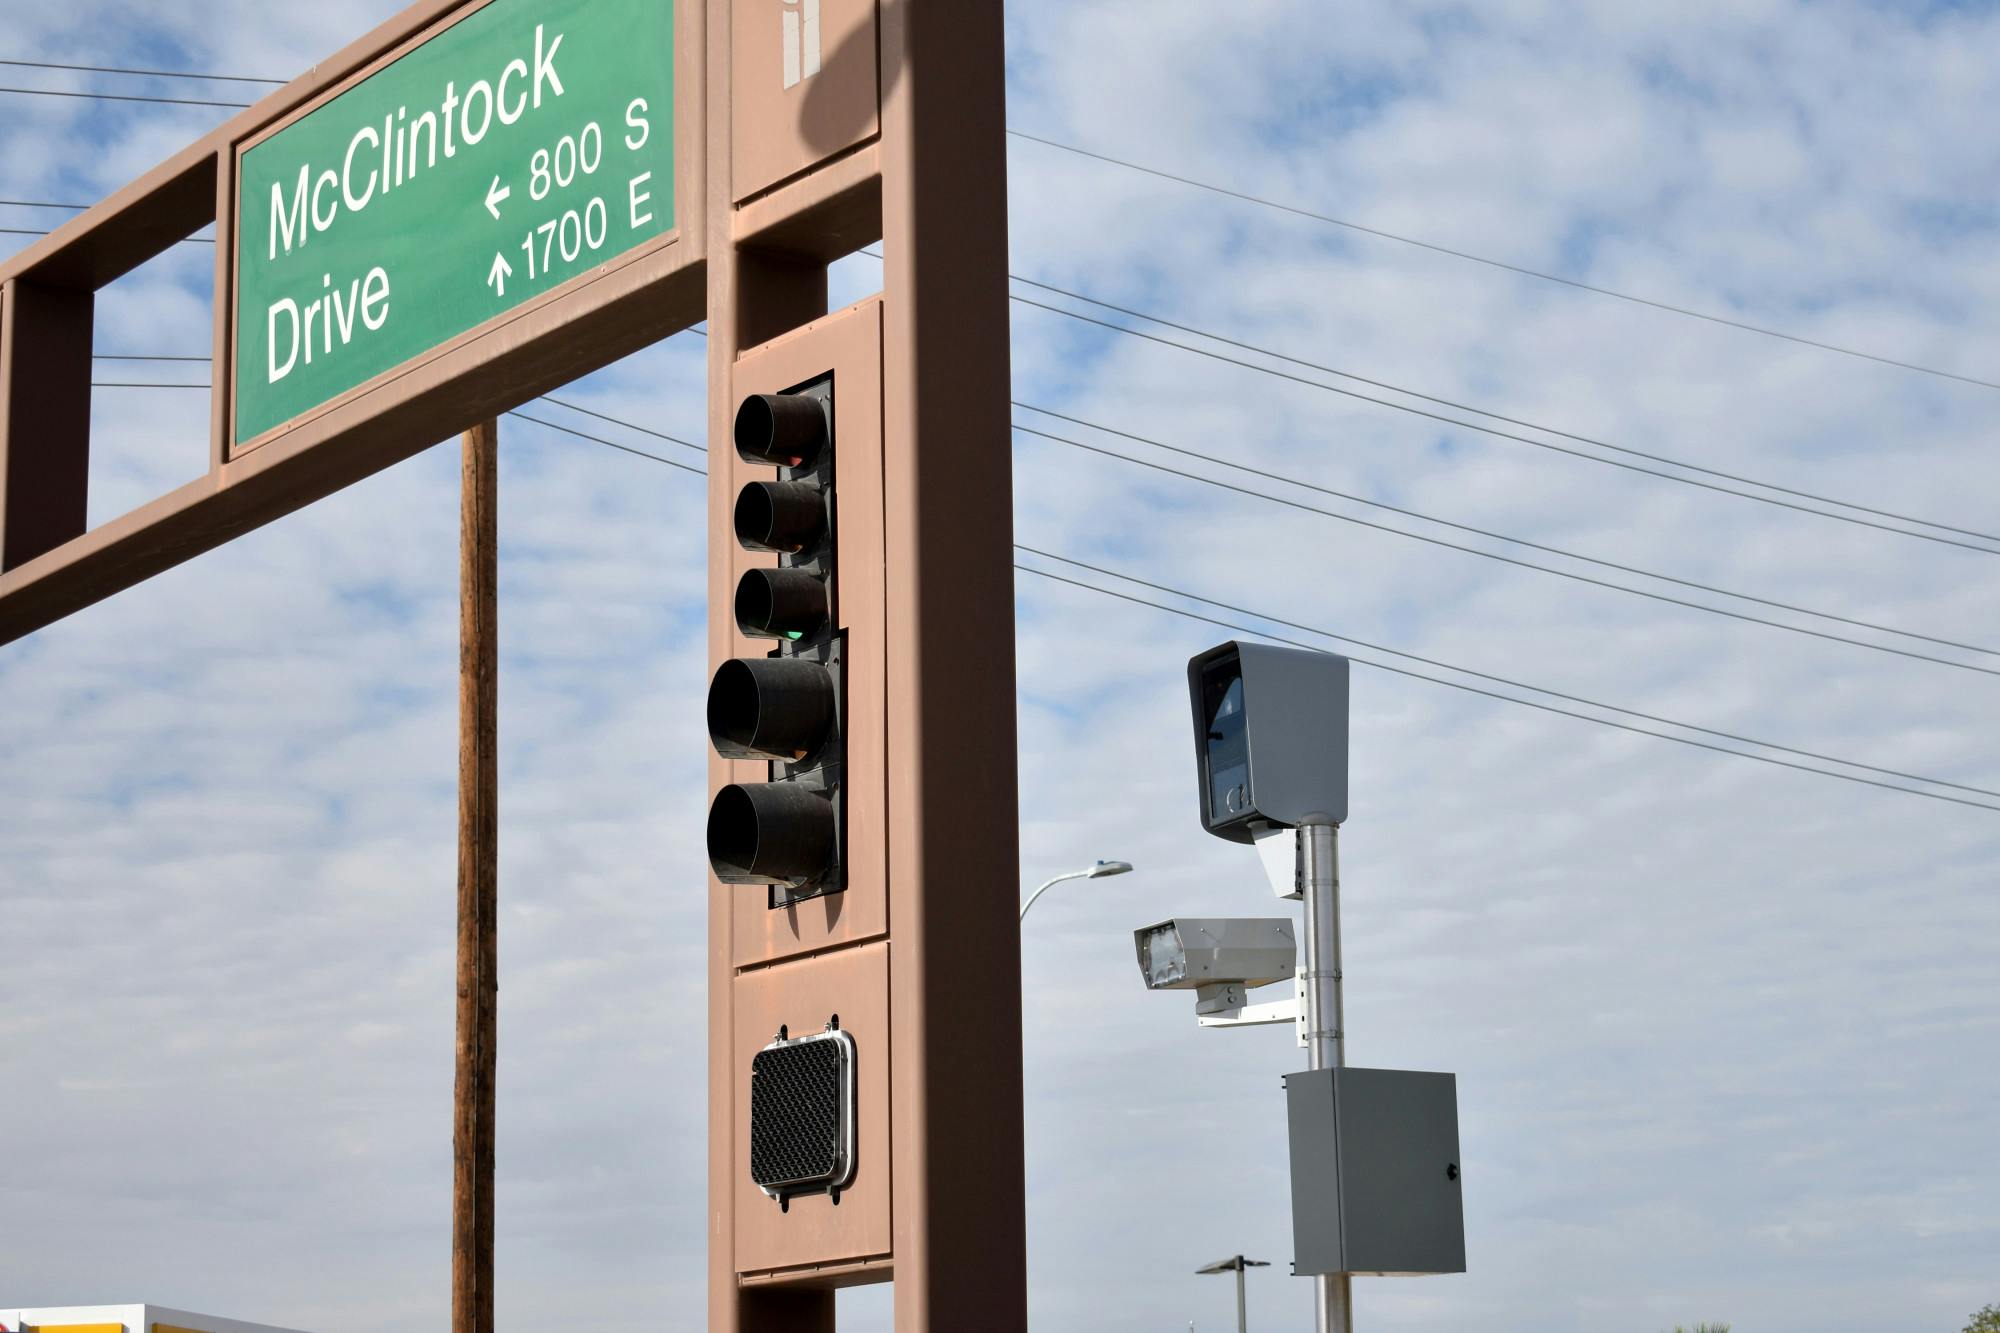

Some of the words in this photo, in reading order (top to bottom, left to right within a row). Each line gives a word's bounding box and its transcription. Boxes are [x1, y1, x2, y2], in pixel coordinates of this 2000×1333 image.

[269, 24, 565, 260] McClintock
[529, 122, 602, 202] 800
[625, 98, 650, 151] S
[522, 197, 607, 280] 1700
[629, 171, 653, 229] E
[268, 266, 390, 384] Drive
